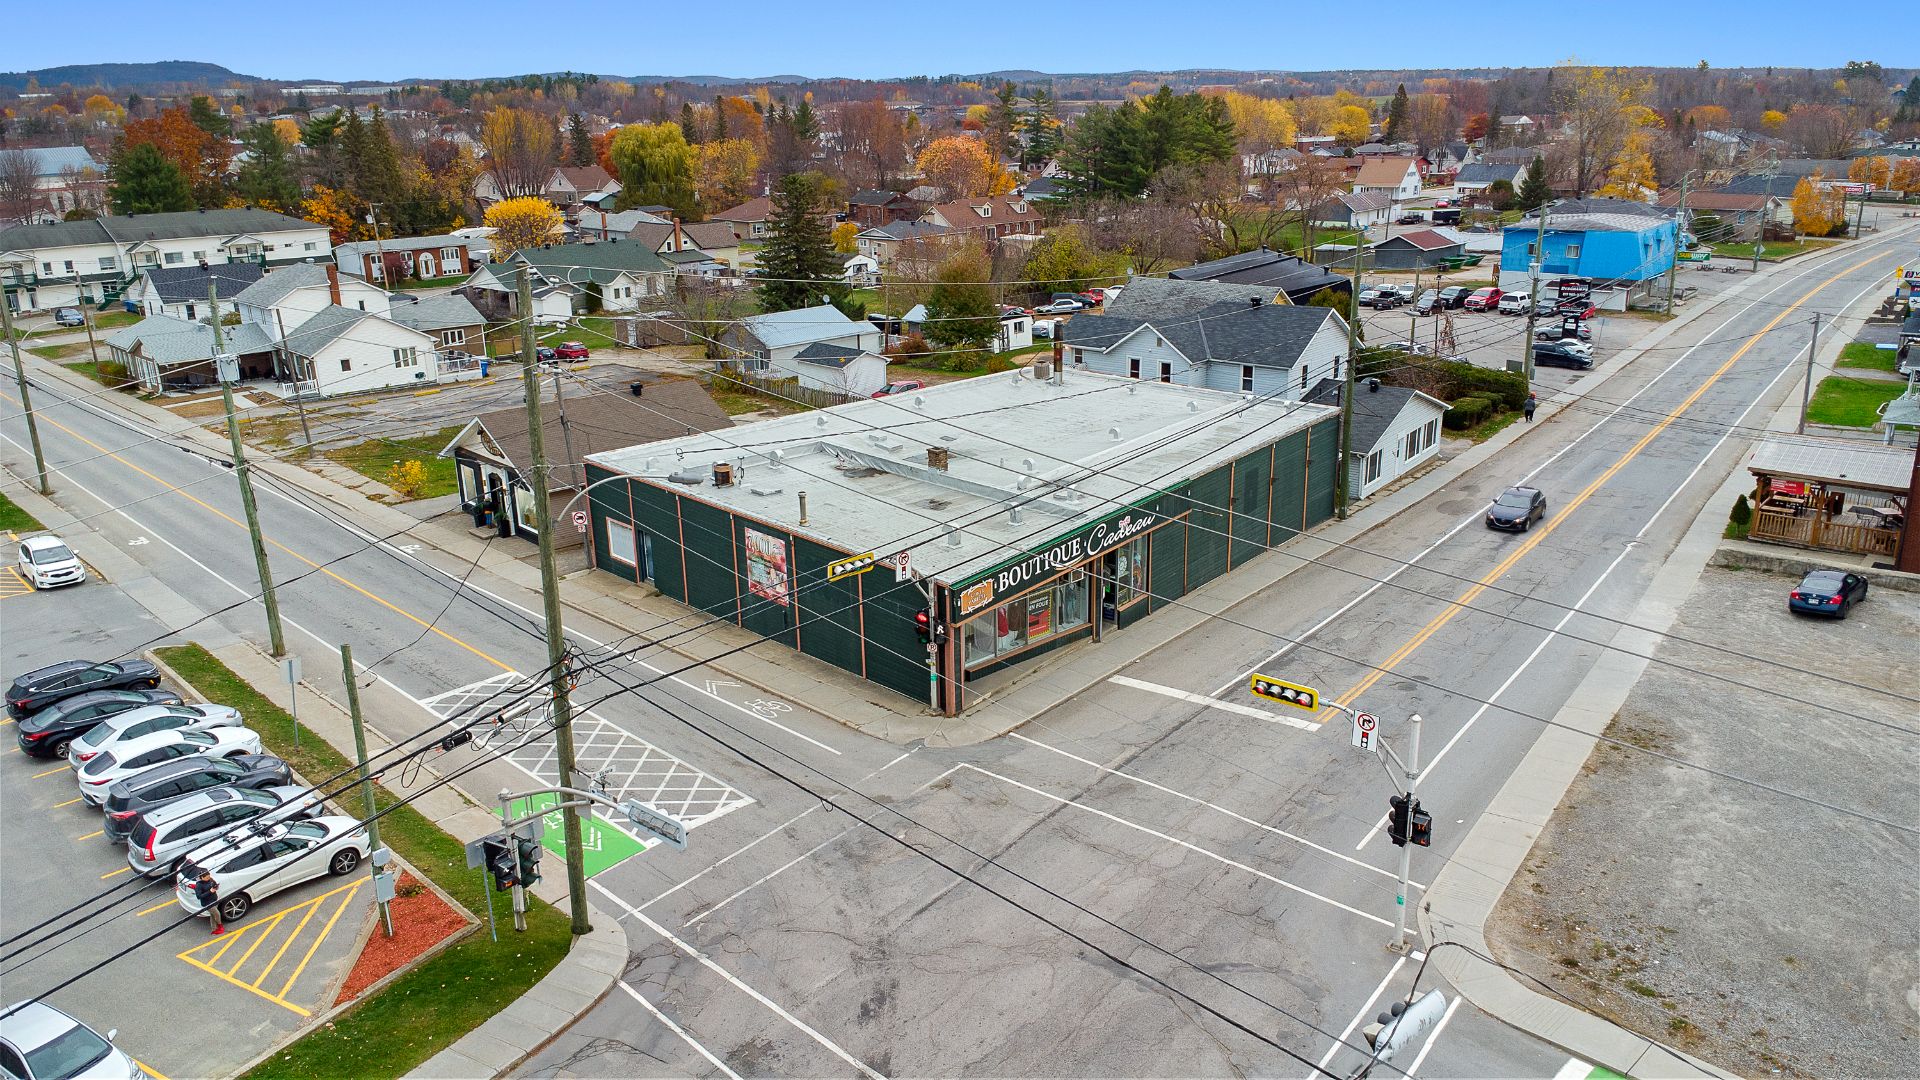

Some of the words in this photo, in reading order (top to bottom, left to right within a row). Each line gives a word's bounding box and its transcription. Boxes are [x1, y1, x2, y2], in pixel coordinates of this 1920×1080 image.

[1680, 252, 1709, 260] SUBWAY
[998, 537, 1082, 592] BOUTIQUE
[1087, 515, 1155, 555] Cadeau
